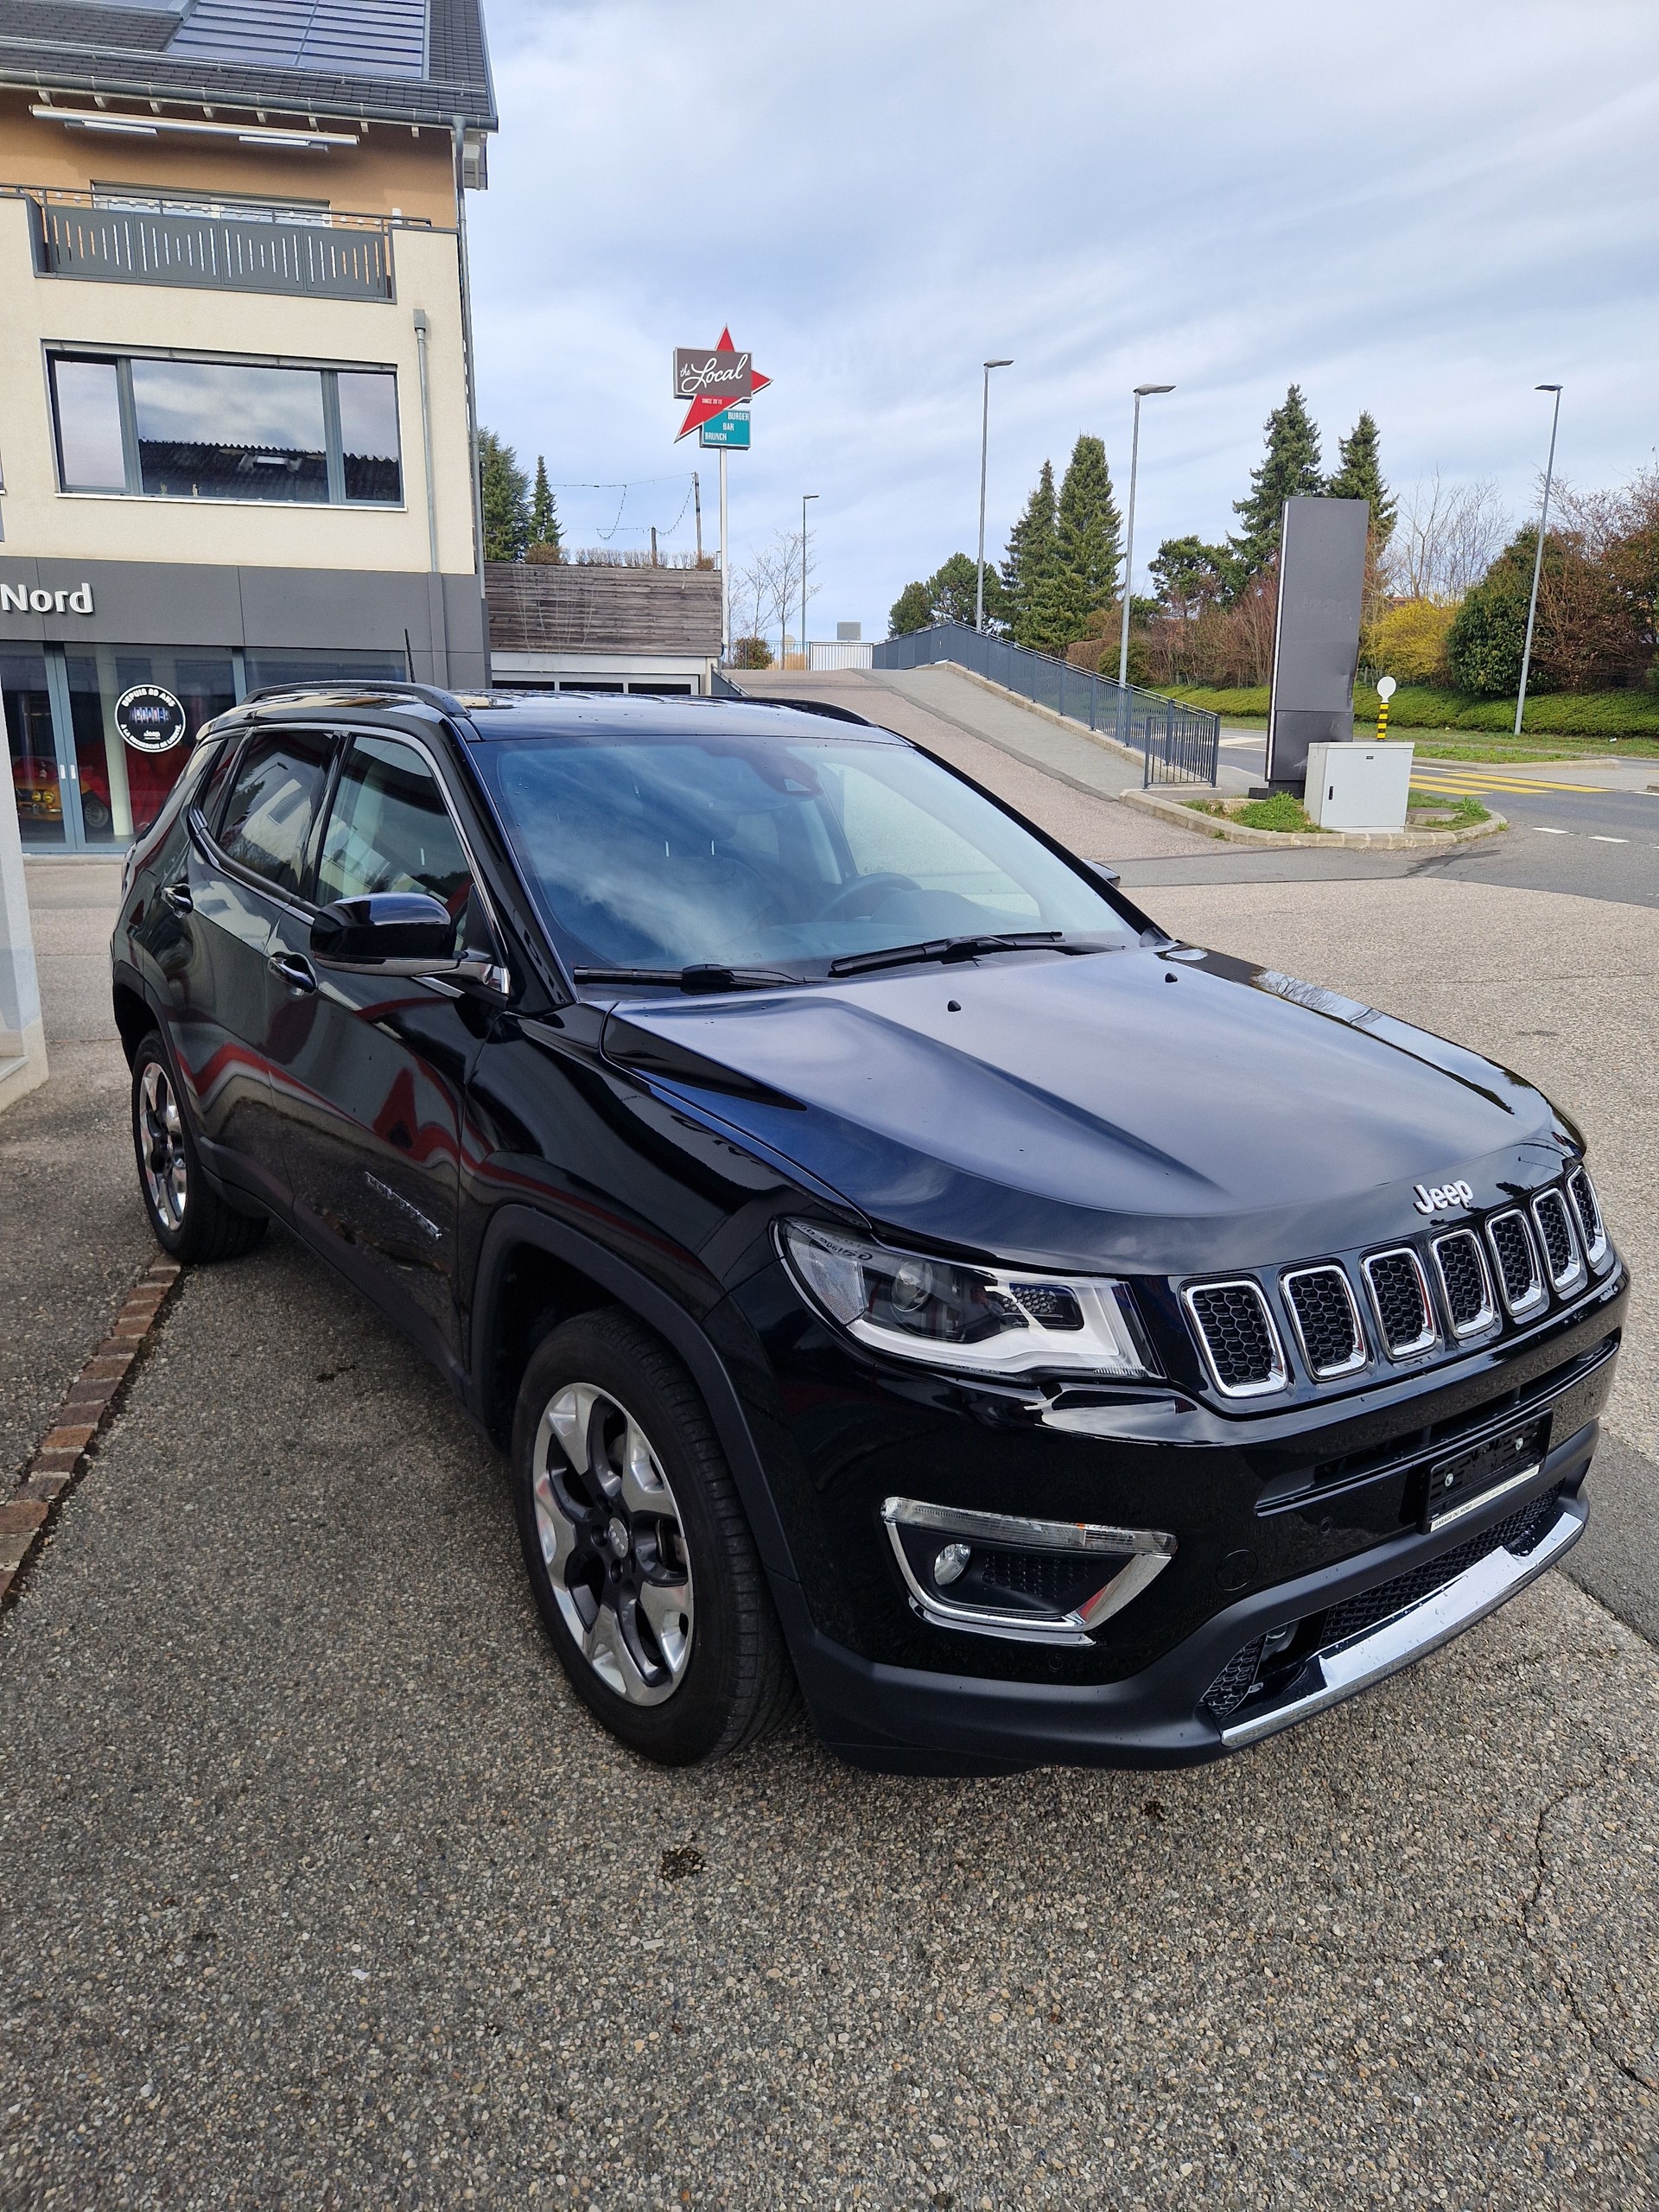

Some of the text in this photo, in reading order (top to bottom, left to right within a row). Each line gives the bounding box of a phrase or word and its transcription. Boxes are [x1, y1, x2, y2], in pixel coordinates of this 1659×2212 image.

[680, 353, 748, 392] the Local
[728, 411, 750, 421] BURGER
[704, 431, 728, 441] BRUNCH
[722, 423, 734, 431] BAR
[0, 582, 94, 613] Nord
[121, 688, 148, 707] DEPUIS
[158, 692, 176, 707] ANS
[1413, 1179, 1473, 1215] Jeep
